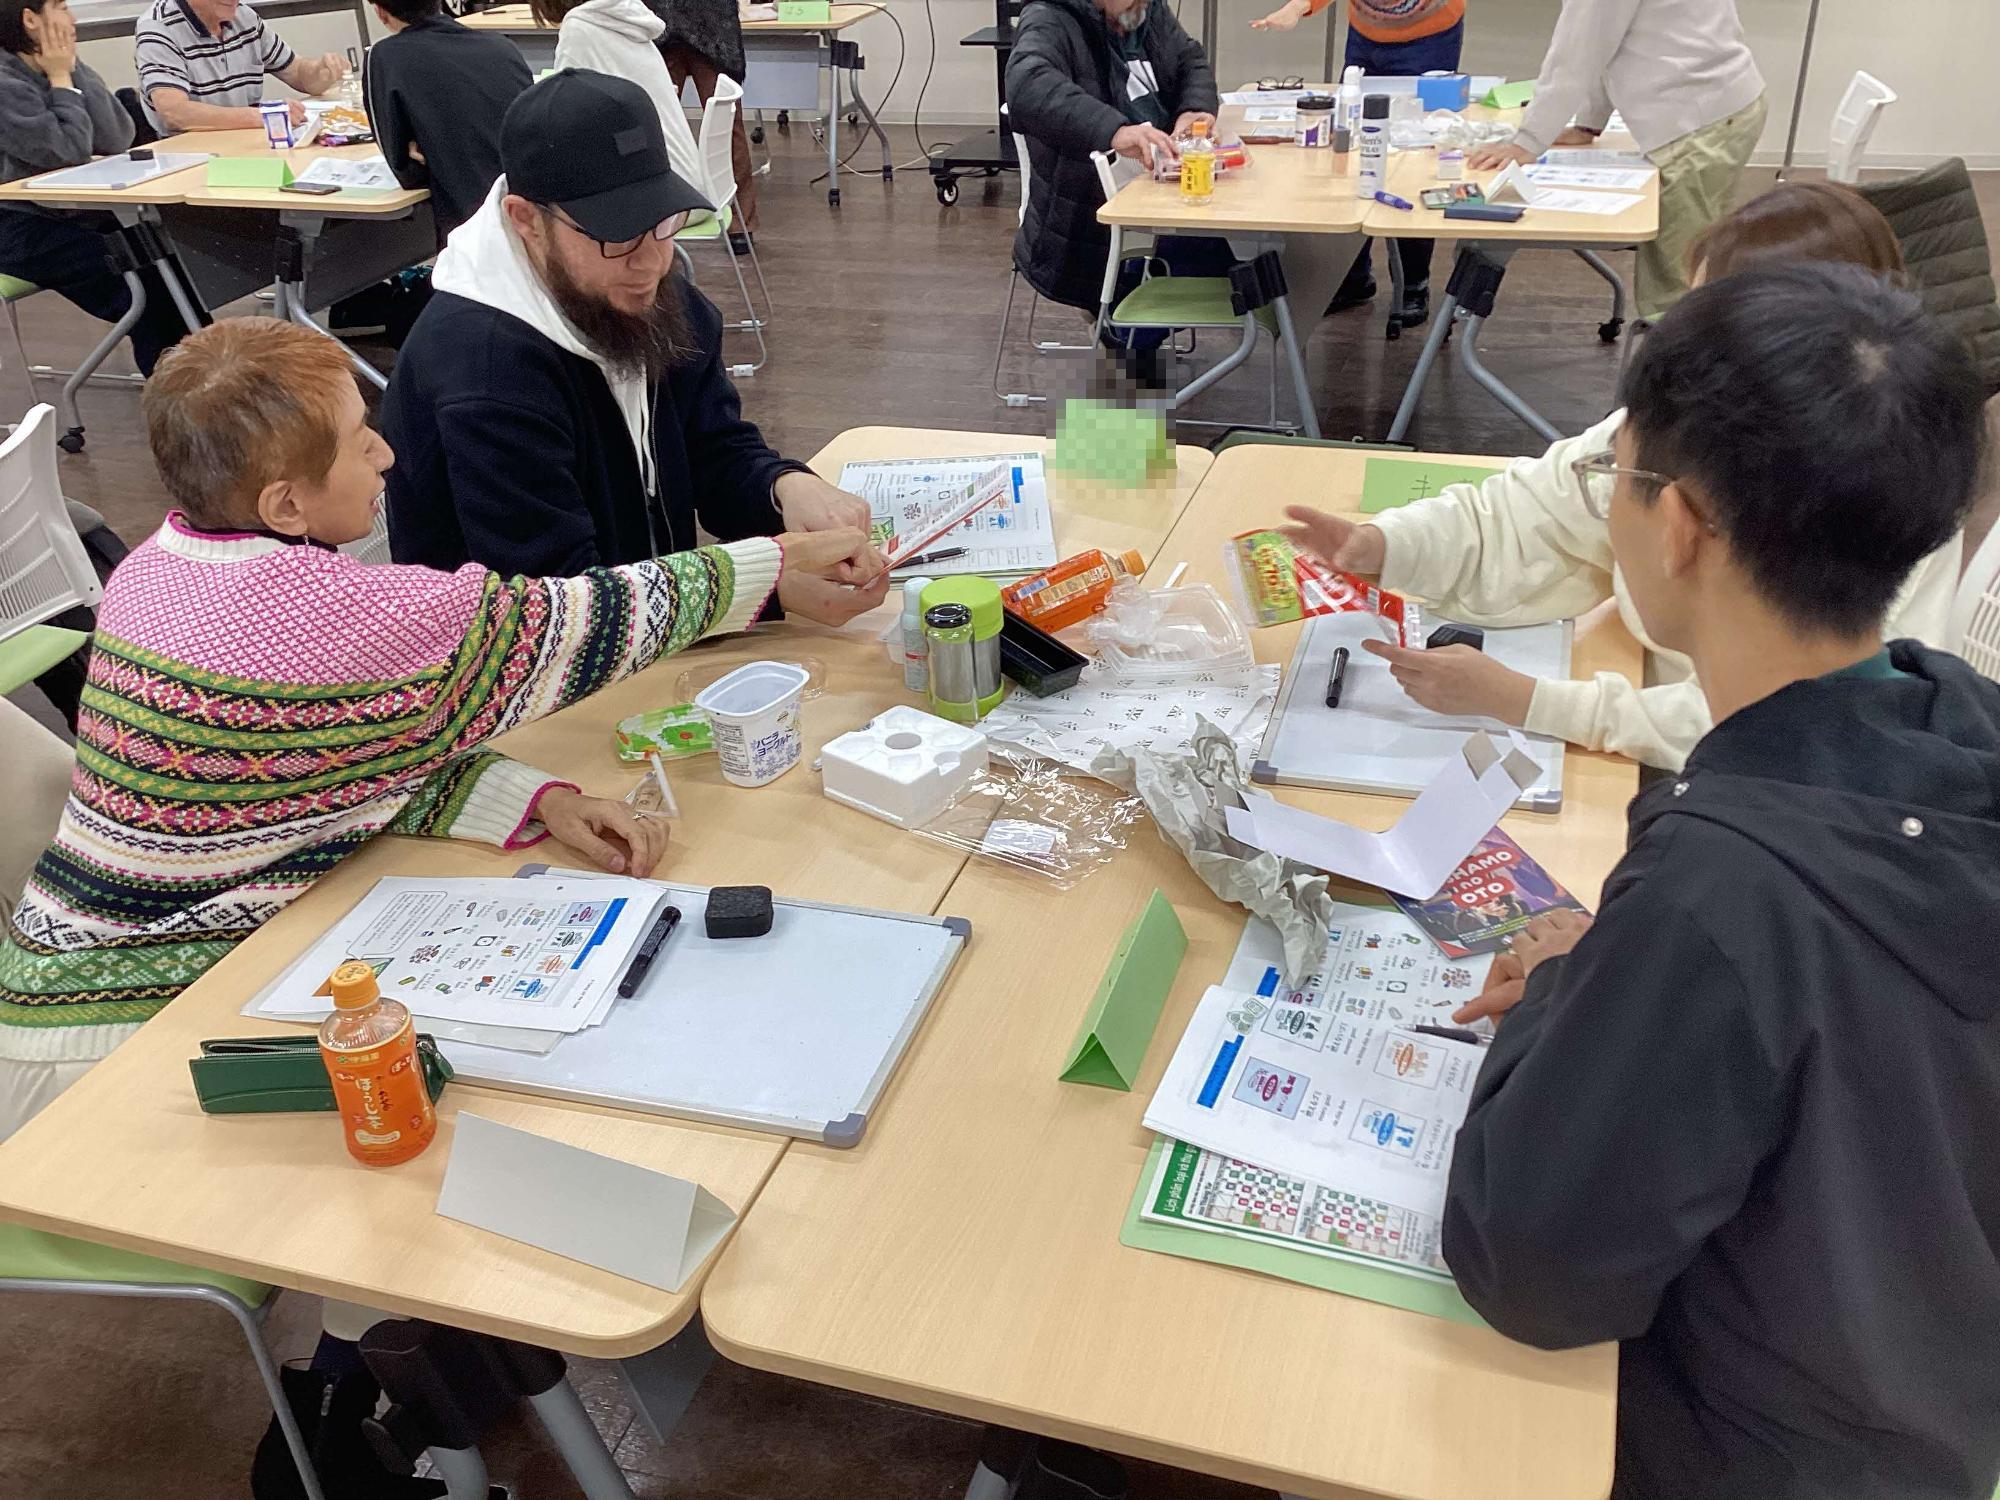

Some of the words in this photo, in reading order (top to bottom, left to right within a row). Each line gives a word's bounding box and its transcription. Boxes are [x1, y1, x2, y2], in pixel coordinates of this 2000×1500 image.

[756, 731, 779, 748] バニラ
[1461, 882, 1504, 904] OTO
[355, 1078, 384, 1130] ほうじ茶
